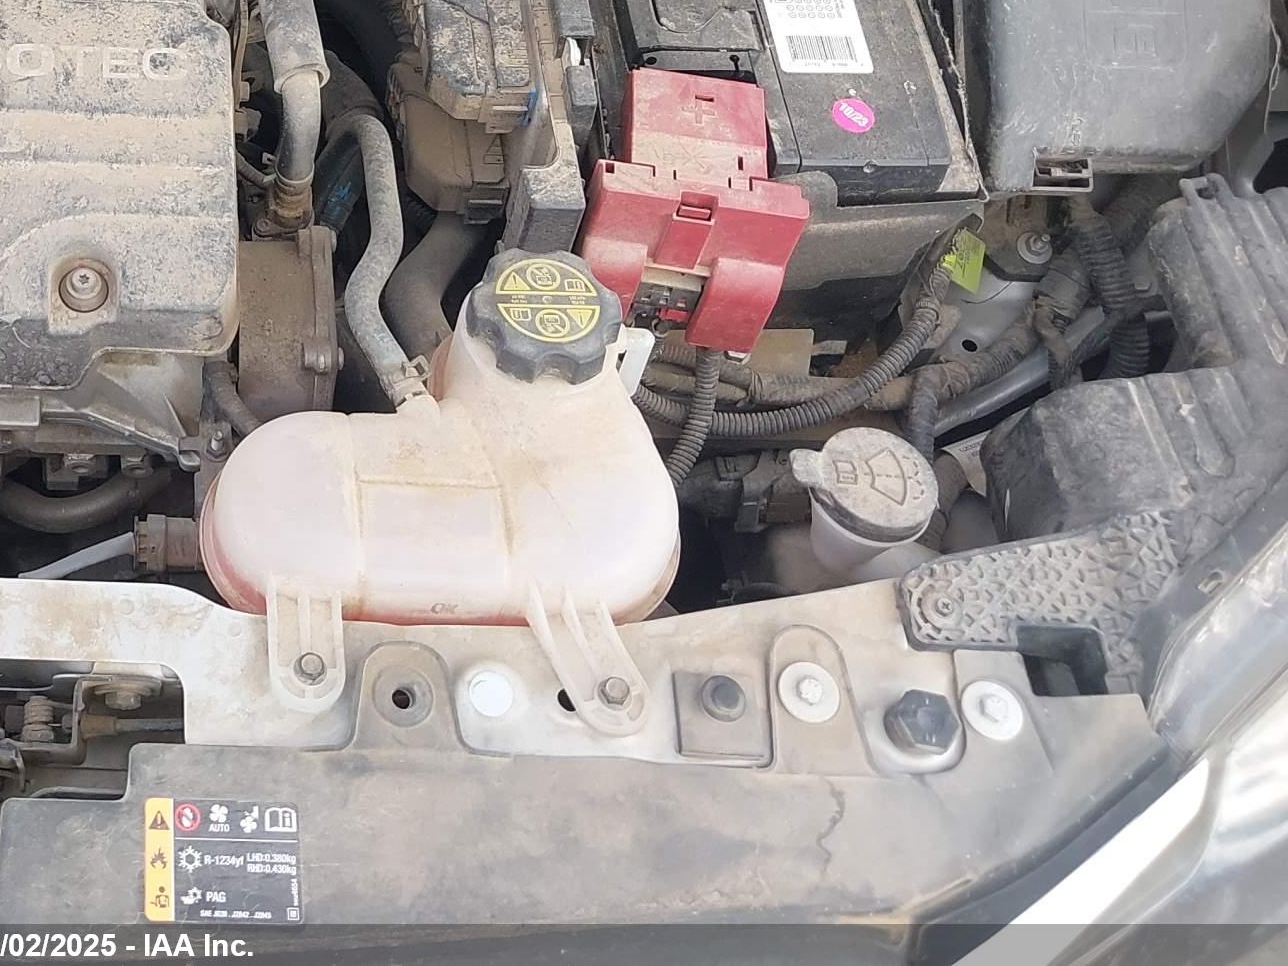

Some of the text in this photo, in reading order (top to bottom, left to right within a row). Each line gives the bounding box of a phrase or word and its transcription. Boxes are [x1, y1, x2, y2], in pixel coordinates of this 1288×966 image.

[838, 100, 869, 128] 10/23
[208, 823, 230, 833] AUTO
[205, 891, 227, 903] PAG
